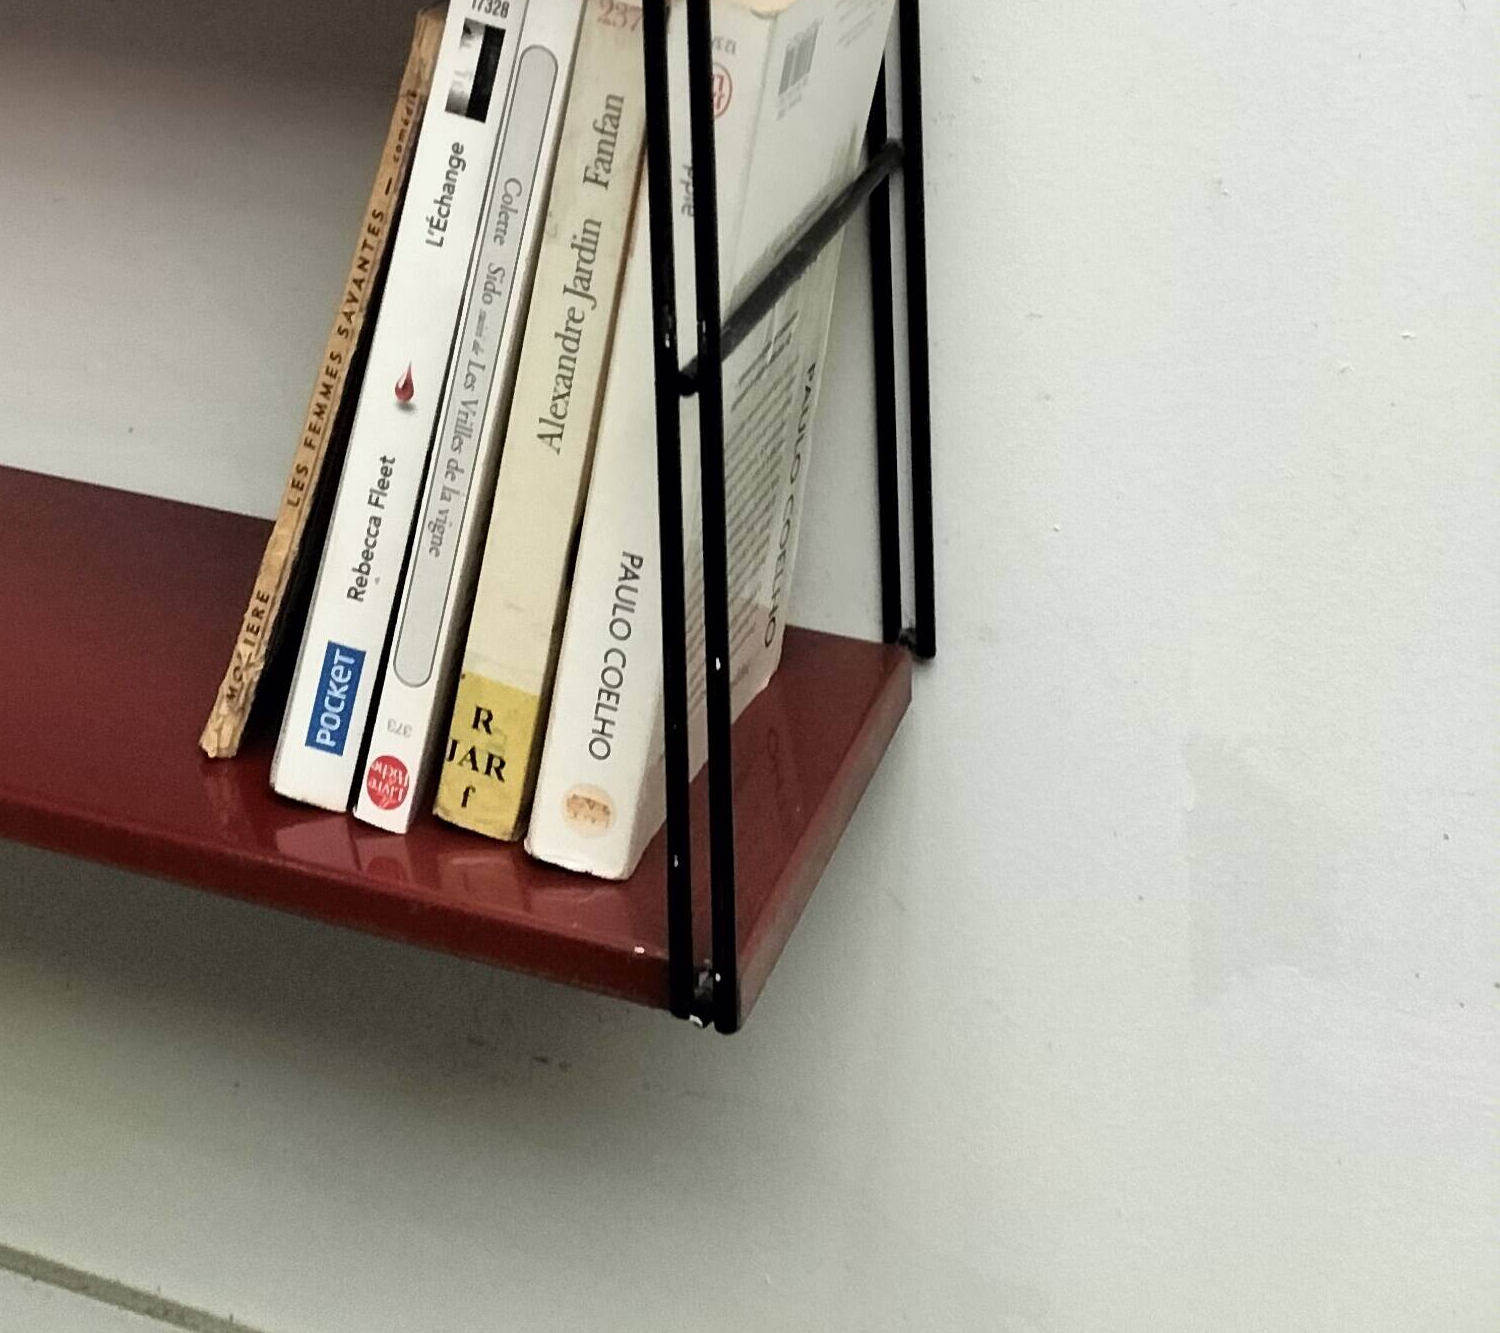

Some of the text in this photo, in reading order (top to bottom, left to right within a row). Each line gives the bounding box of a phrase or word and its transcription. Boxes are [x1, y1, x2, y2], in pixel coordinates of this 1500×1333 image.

[583, 93, 624, 190] Fanfan
[493, 177, 523, 246] Colette
[482, 262, 505, 305] Sido
[286, 464, 309, 508] LES
[302, 349, 344, 450] FEMMES
[336, 207, 386, 339] SAVANTES
[536, 217, 602, 456] Alexandre Jardin
[463, 359, 485, 391] Les
[450, 397, 478, 455] Vrilles
[445, 458, 465, 481] de
[440, 485, 460, 509] la
[763, 361, 816, 648] PAULO COELHO
[347, 454, 396, 603] Rebecca Fleet
[427, 509, 453, 558] vigne
[608, 551, 644, 641] PAULO
[387, 718, 412, 738] 373
[471, 705, 494, 735] R
[588, 648, 627, 761] COELHO
[446, 739, 506, 782] JAR
[461, 785, 476, 808] f
